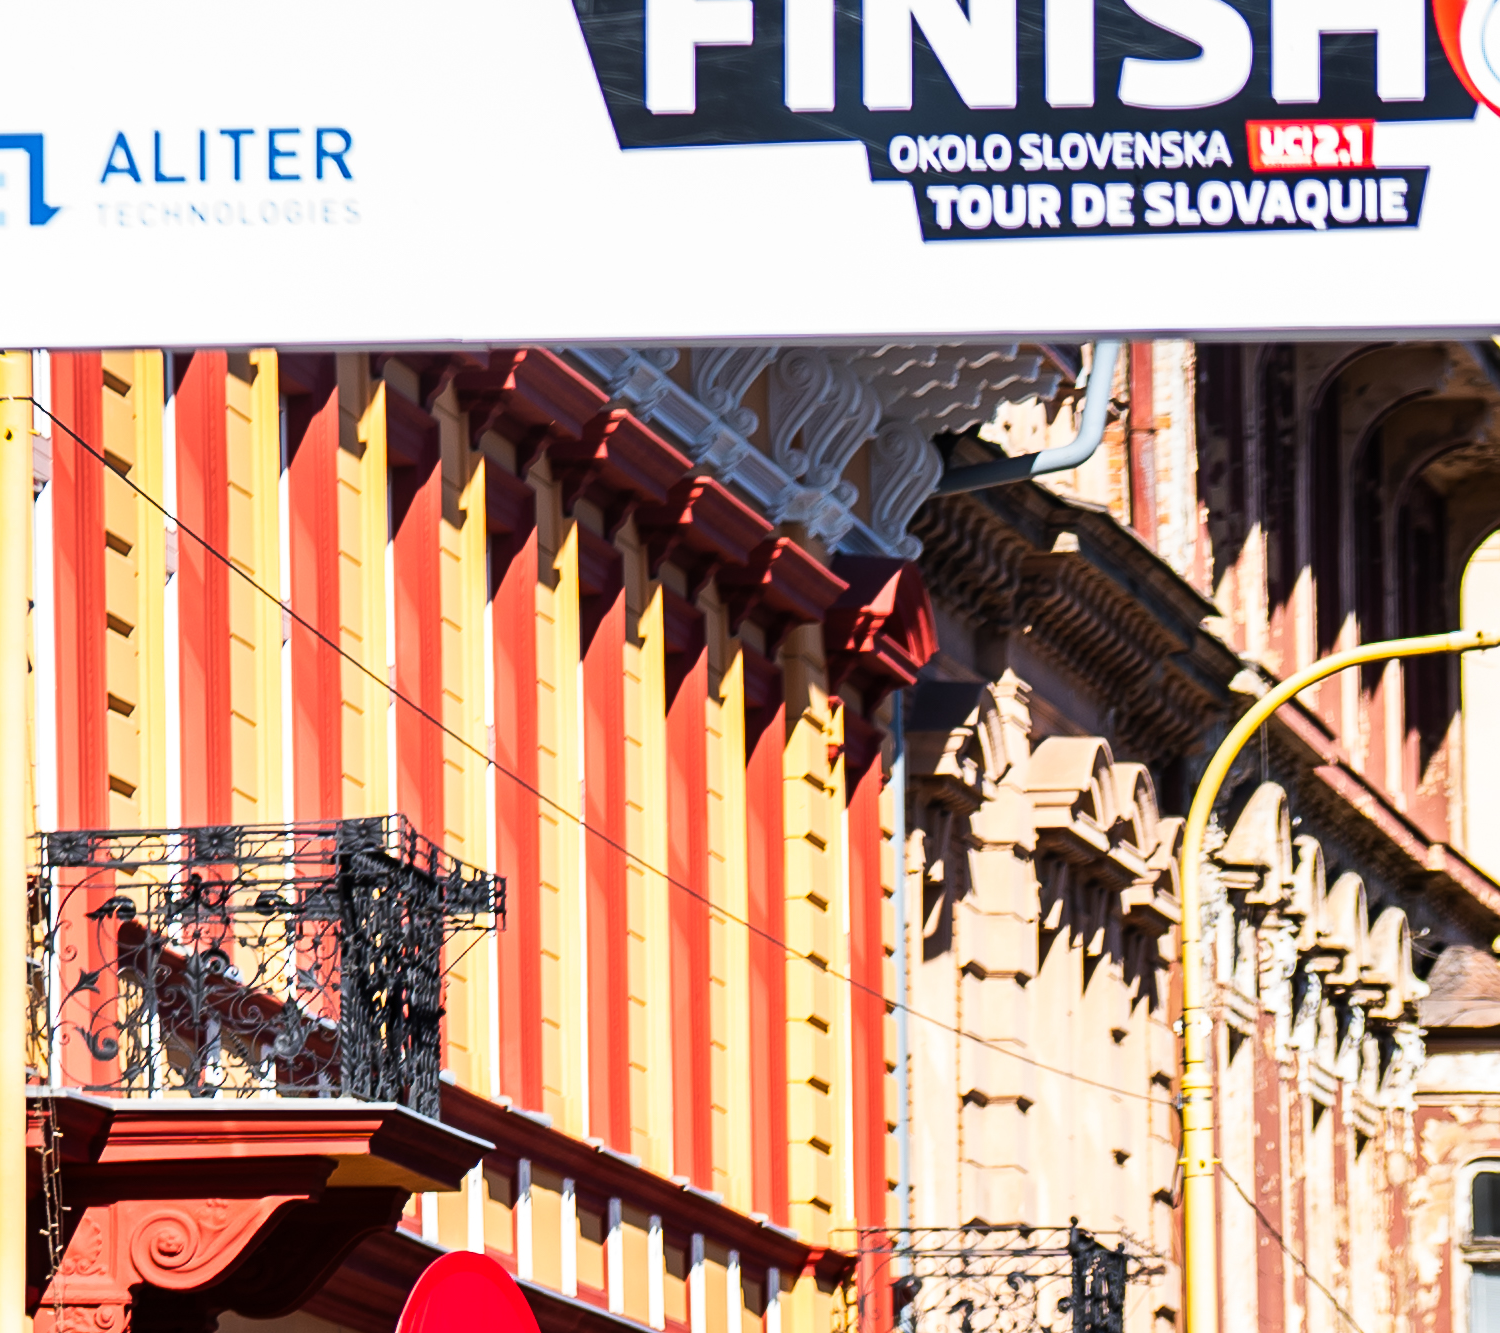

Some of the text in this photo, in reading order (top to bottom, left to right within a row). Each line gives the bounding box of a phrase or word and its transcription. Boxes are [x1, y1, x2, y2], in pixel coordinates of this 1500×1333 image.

[637, 0, 1429, 114] FINISH
[99, 126, 355, 184] ALITER
[888, 130, 1234, 174] OKOLO SLOVENSKA
[926, 178, 1409, 231] TOUR DE SLOVAQUIE
